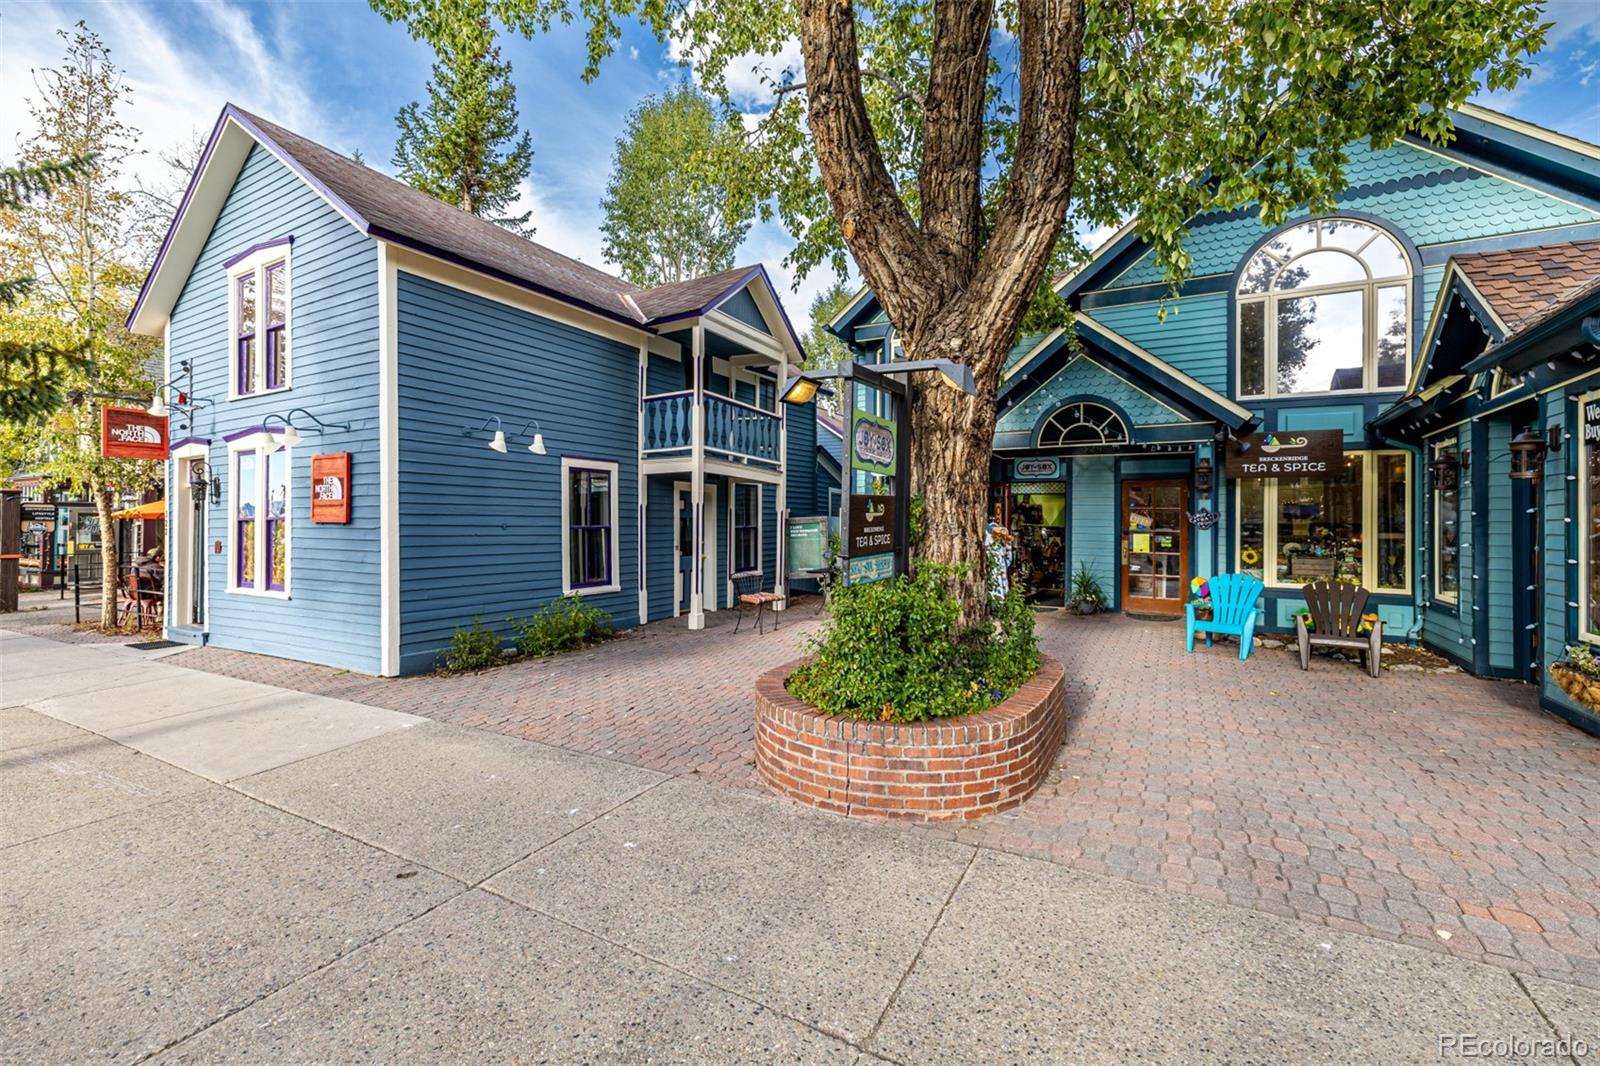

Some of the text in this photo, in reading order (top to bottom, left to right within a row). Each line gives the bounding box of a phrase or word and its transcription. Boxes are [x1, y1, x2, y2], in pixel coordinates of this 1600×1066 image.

[126, 424, 145, 432] THE
[111, 429, 145, 438] NORTH
[118, 435, 145, 443] FACE
[1241, 462, 1327, 473] TEA & SPICE
[856, 533, 891, 548] TEA & SPICE
